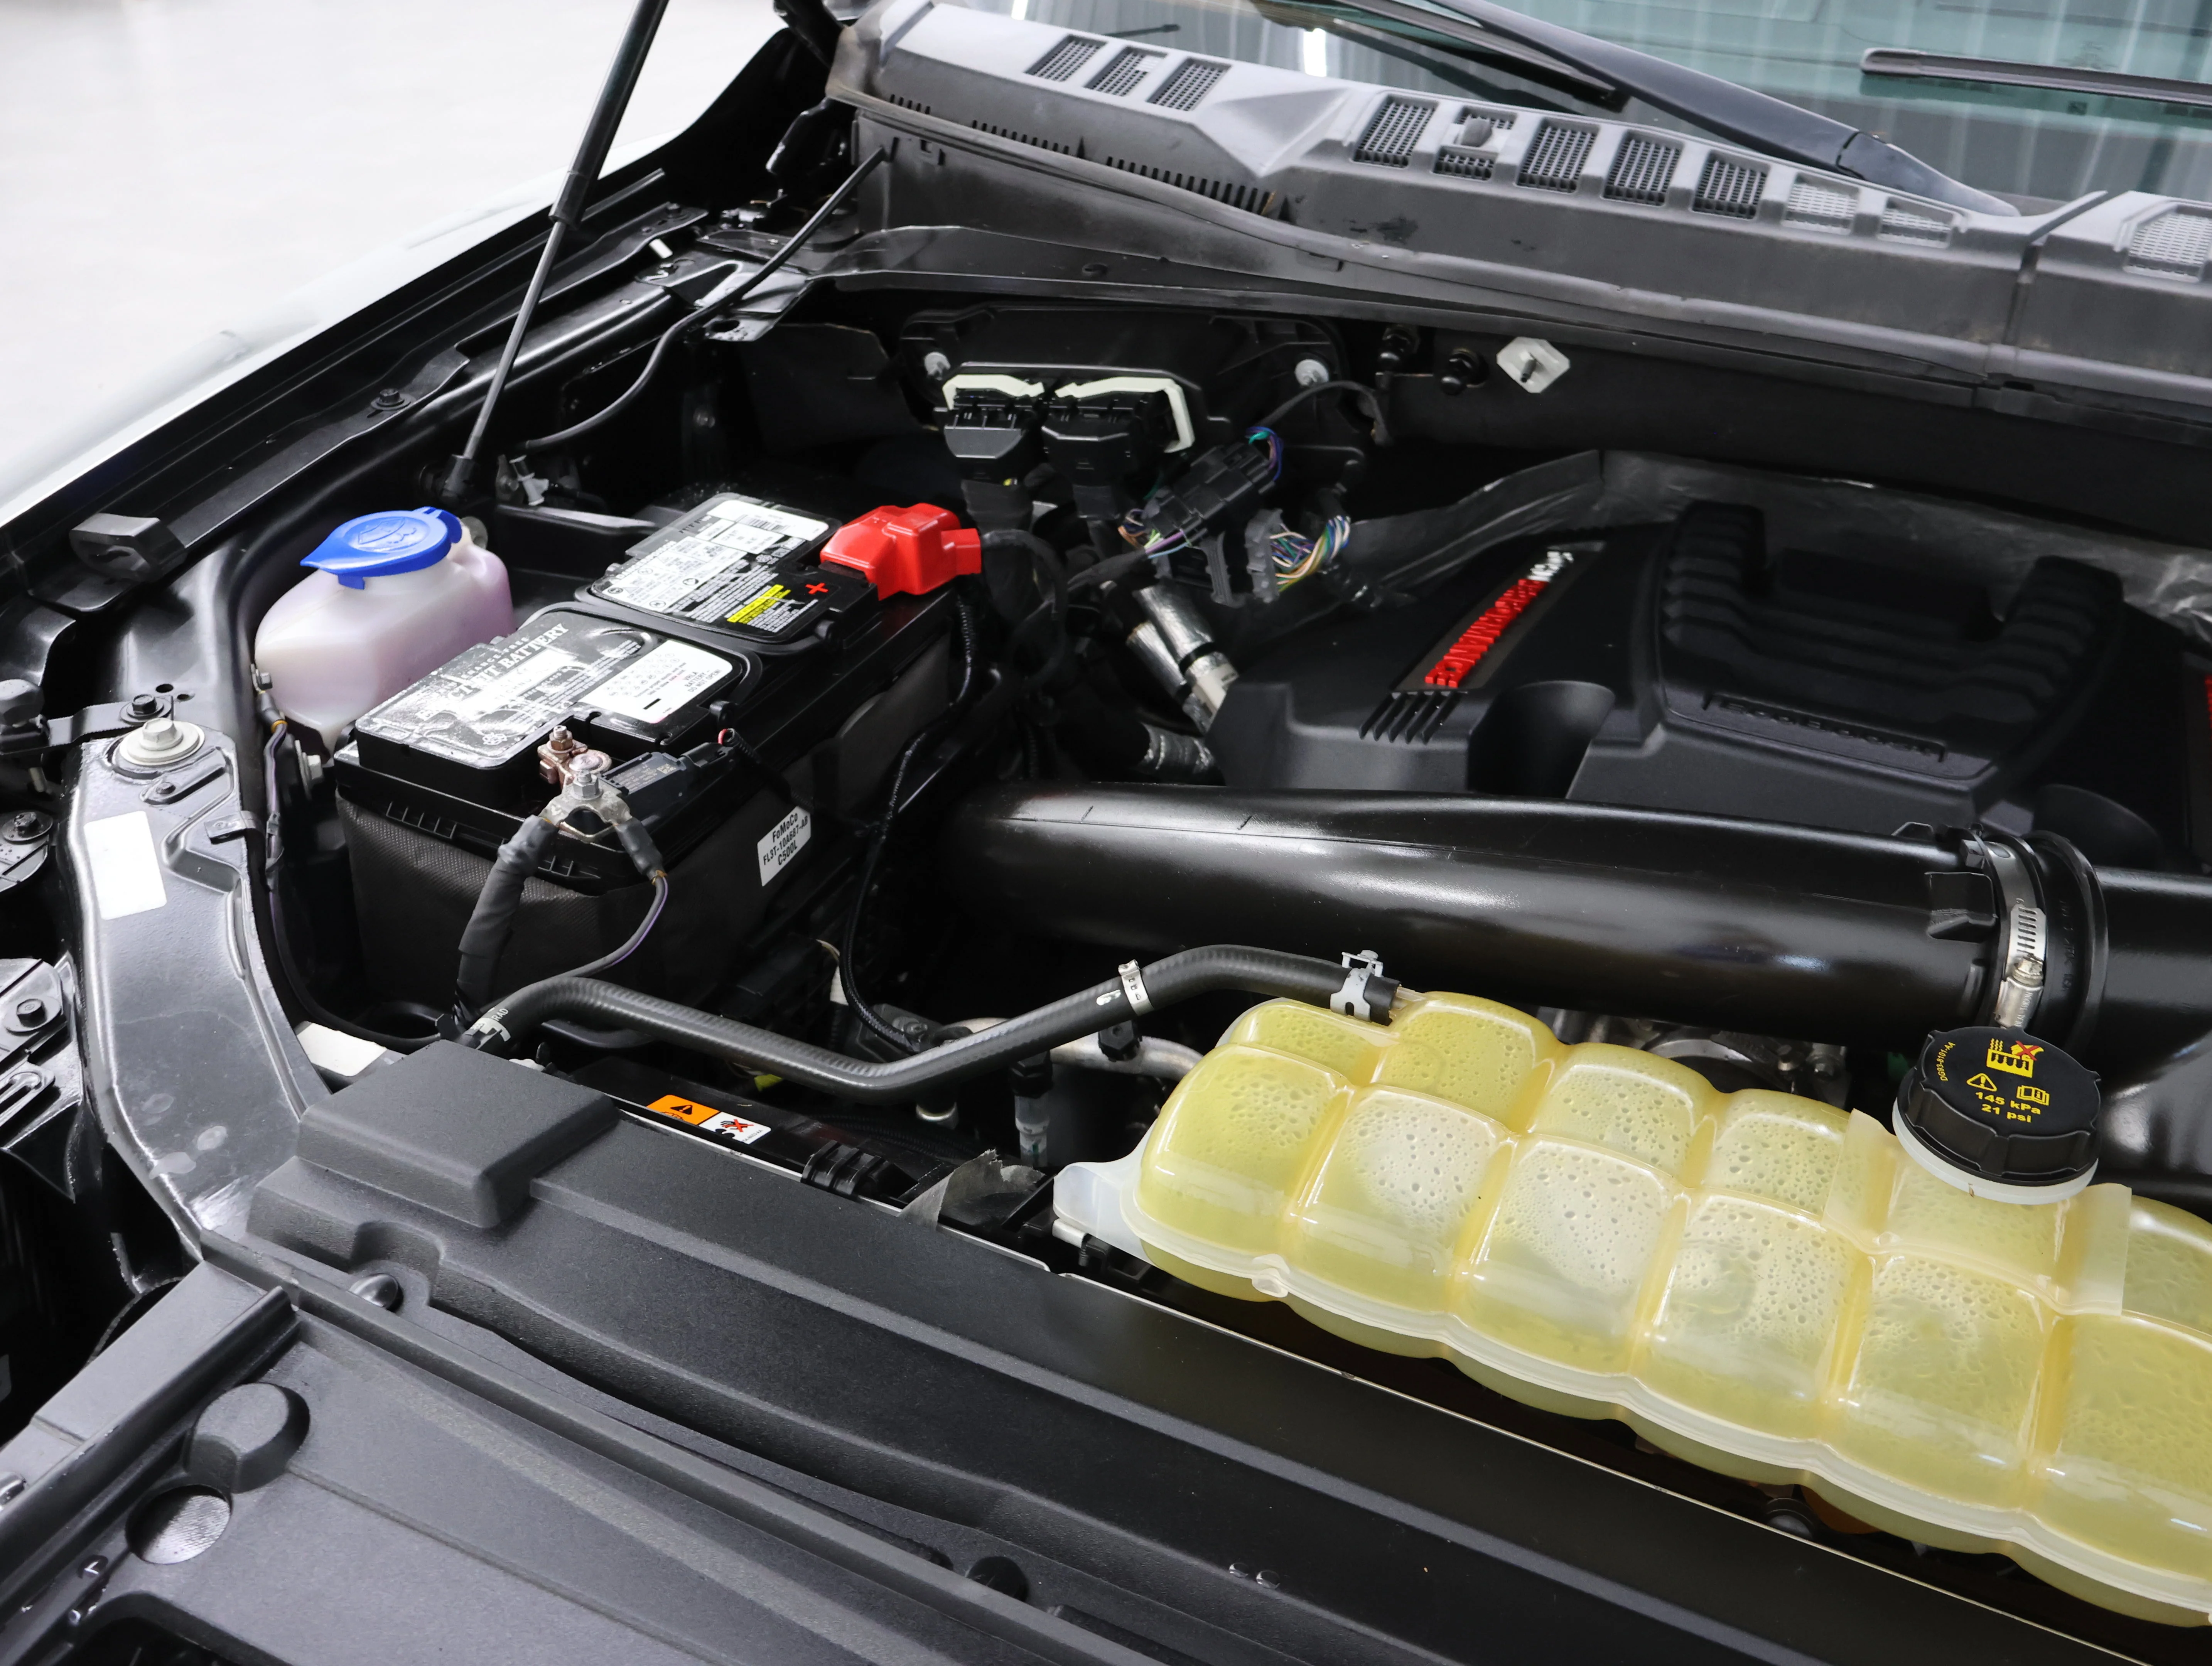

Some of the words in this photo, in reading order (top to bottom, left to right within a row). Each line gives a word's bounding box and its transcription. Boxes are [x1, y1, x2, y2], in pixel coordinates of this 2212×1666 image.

[498, 622, 569, 666] BATTERY
[685, 672, 706, 688] BATTERY
[772, 813, 798, 843] FoMoCo
[778, 840, 798, 866] C500L
[491, 1008, 509, 1021] RAD
[1935, 1042, 1956, 1082] DG93-8101-AA
[1975, 1091, 2005, 1106] 145
[2010, 1100, 2042, 1115] kPa
[1981, 1103, 2000, 1116] 21
[2006, 1111, 2031, 1123] psi
